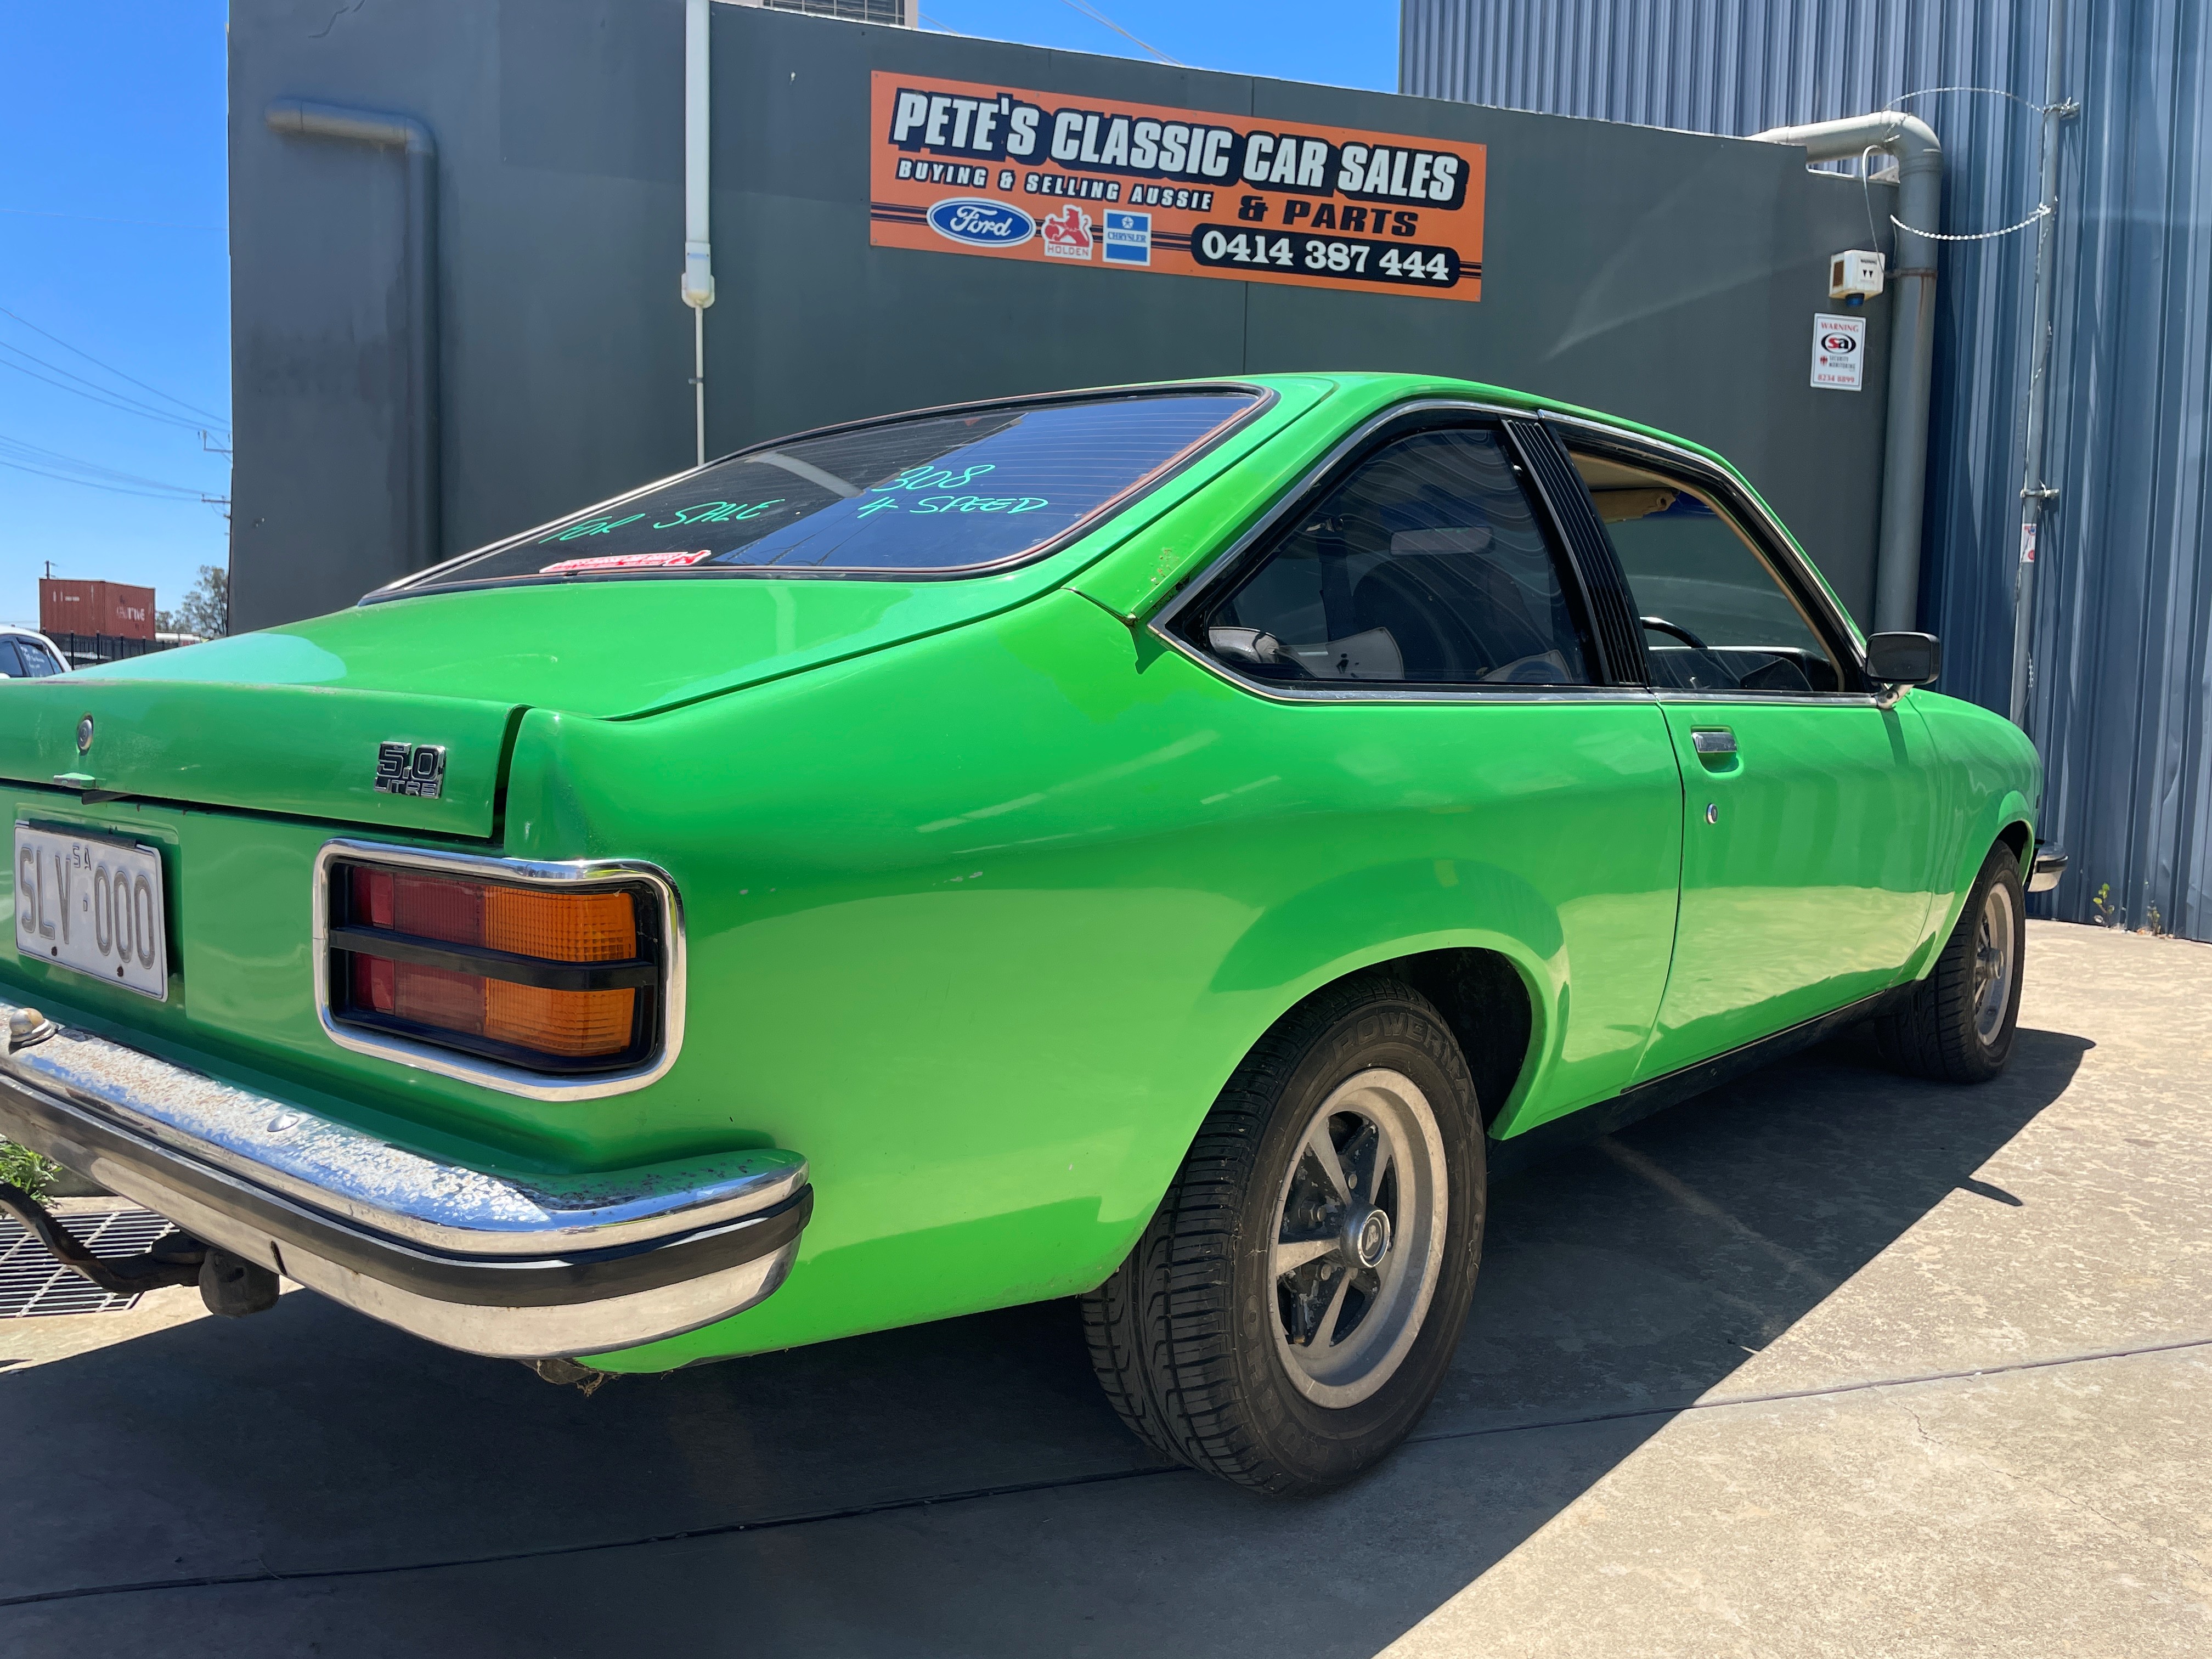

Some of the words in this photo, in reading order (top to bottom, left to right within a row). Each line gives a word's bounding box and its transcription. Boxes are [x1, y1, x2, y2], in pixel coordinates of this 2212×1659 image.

[893, 92, 1040, 155] PETE'S
[1051, 111, 1234, 177] CLASSIC
[1243, 134, 1328, 188] CAR
[1338, 145, 1459, 201] SALES
[898, 160, 988, 187] BUYING
[999, 170, 1015, 190] &
[1025, 173, 1120, 201] SELLING
[1131, 184, 1212, 211] AUSSIE
[949, 205, 1013, 236] Ford
[1238, 195, 1268, 222] &
[1282, 199, 1419, 237] PARTS
[1047, 245, 1090, 256] HOLDEN
[1107, 230, 1147, 243] CHRYSLER
[1201, 230, 1294, 266] 0414
[1304, 240, 1370, 273] 387
[1378, 249, 1449, 281] 444
[1821, 321, 1859, 332] WARNING
[871, 464, 996, 492] 308
[653, 498, 786, 529] SALE
[857, 495, 899, 519] 4
[909, 495, 1049, 514] SPEED
[377, 741, 445, 781] 5.0
[374, 777, 440, 799] LITRE
[72, 845, 91, 871] SA
[1331, 1012, 1481, 1142] POWERMAX
